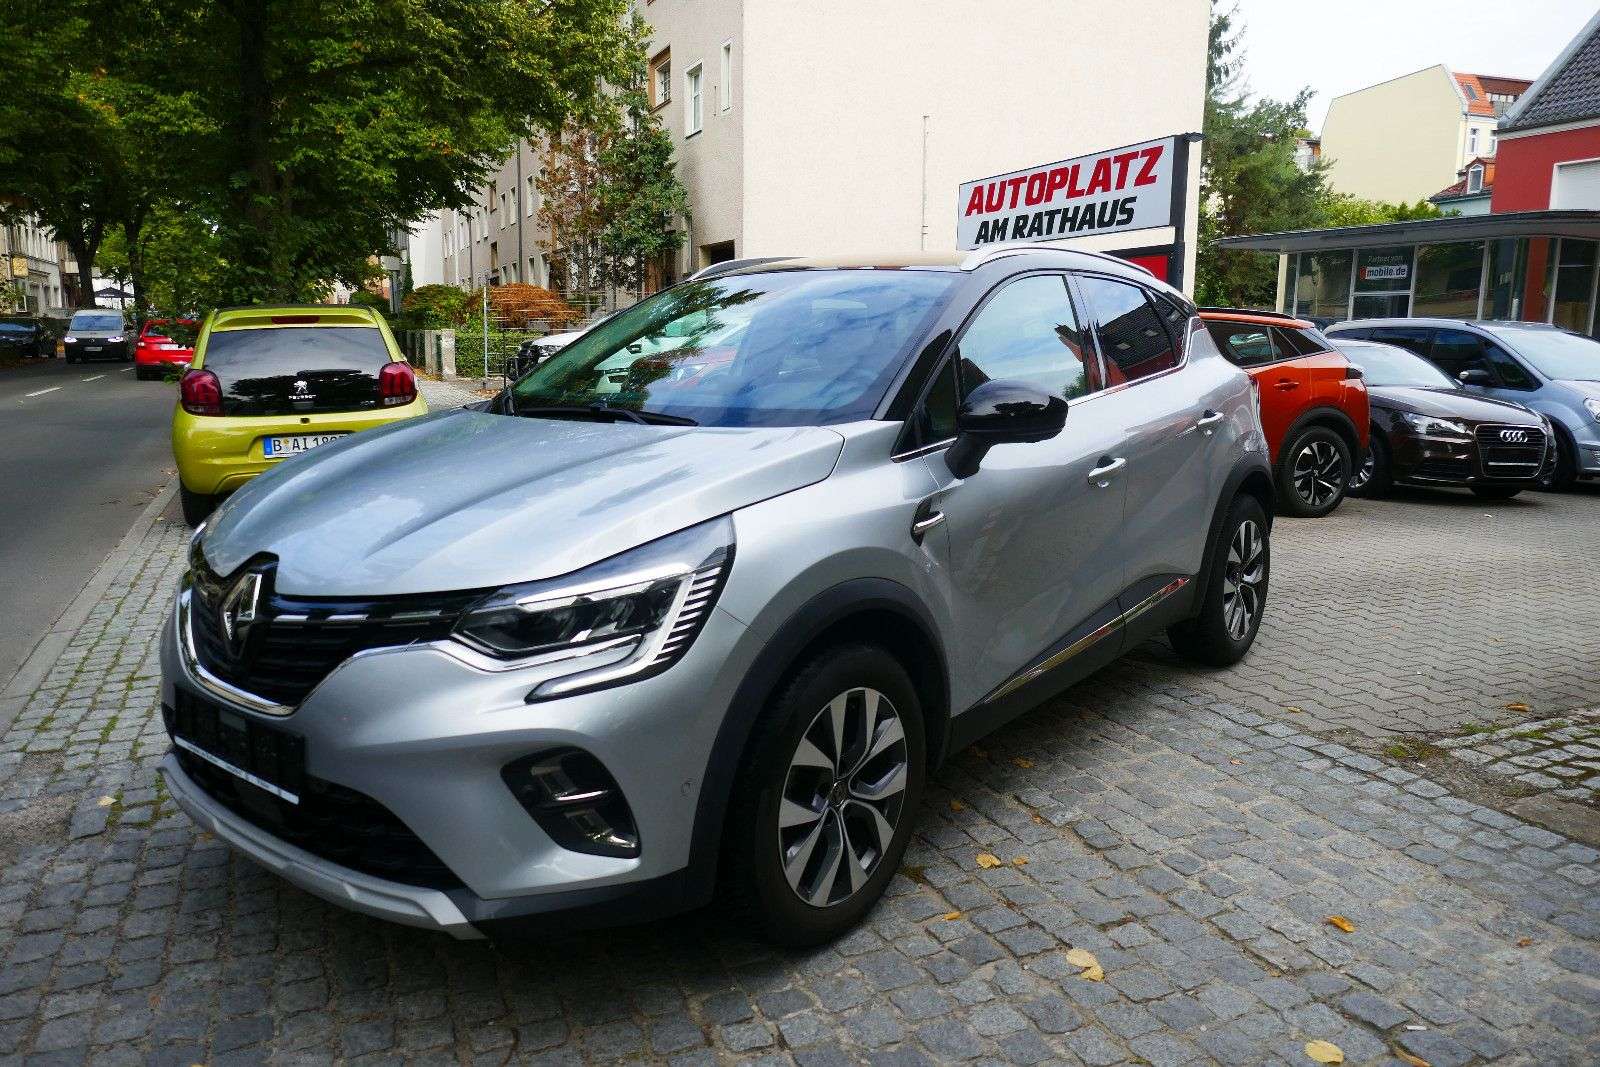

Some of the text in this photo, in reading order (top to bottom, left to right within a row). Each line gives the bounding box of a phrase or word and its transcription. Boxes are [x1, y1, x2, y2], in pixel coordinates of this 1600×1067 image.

[964, 144, 1165, 217] AUTOPLATZ
[974, 196, 1138, 245] AM RATHAUS
[1367, 266, 1407, 278] mobile.de
[272, 439, 282, 452] B
